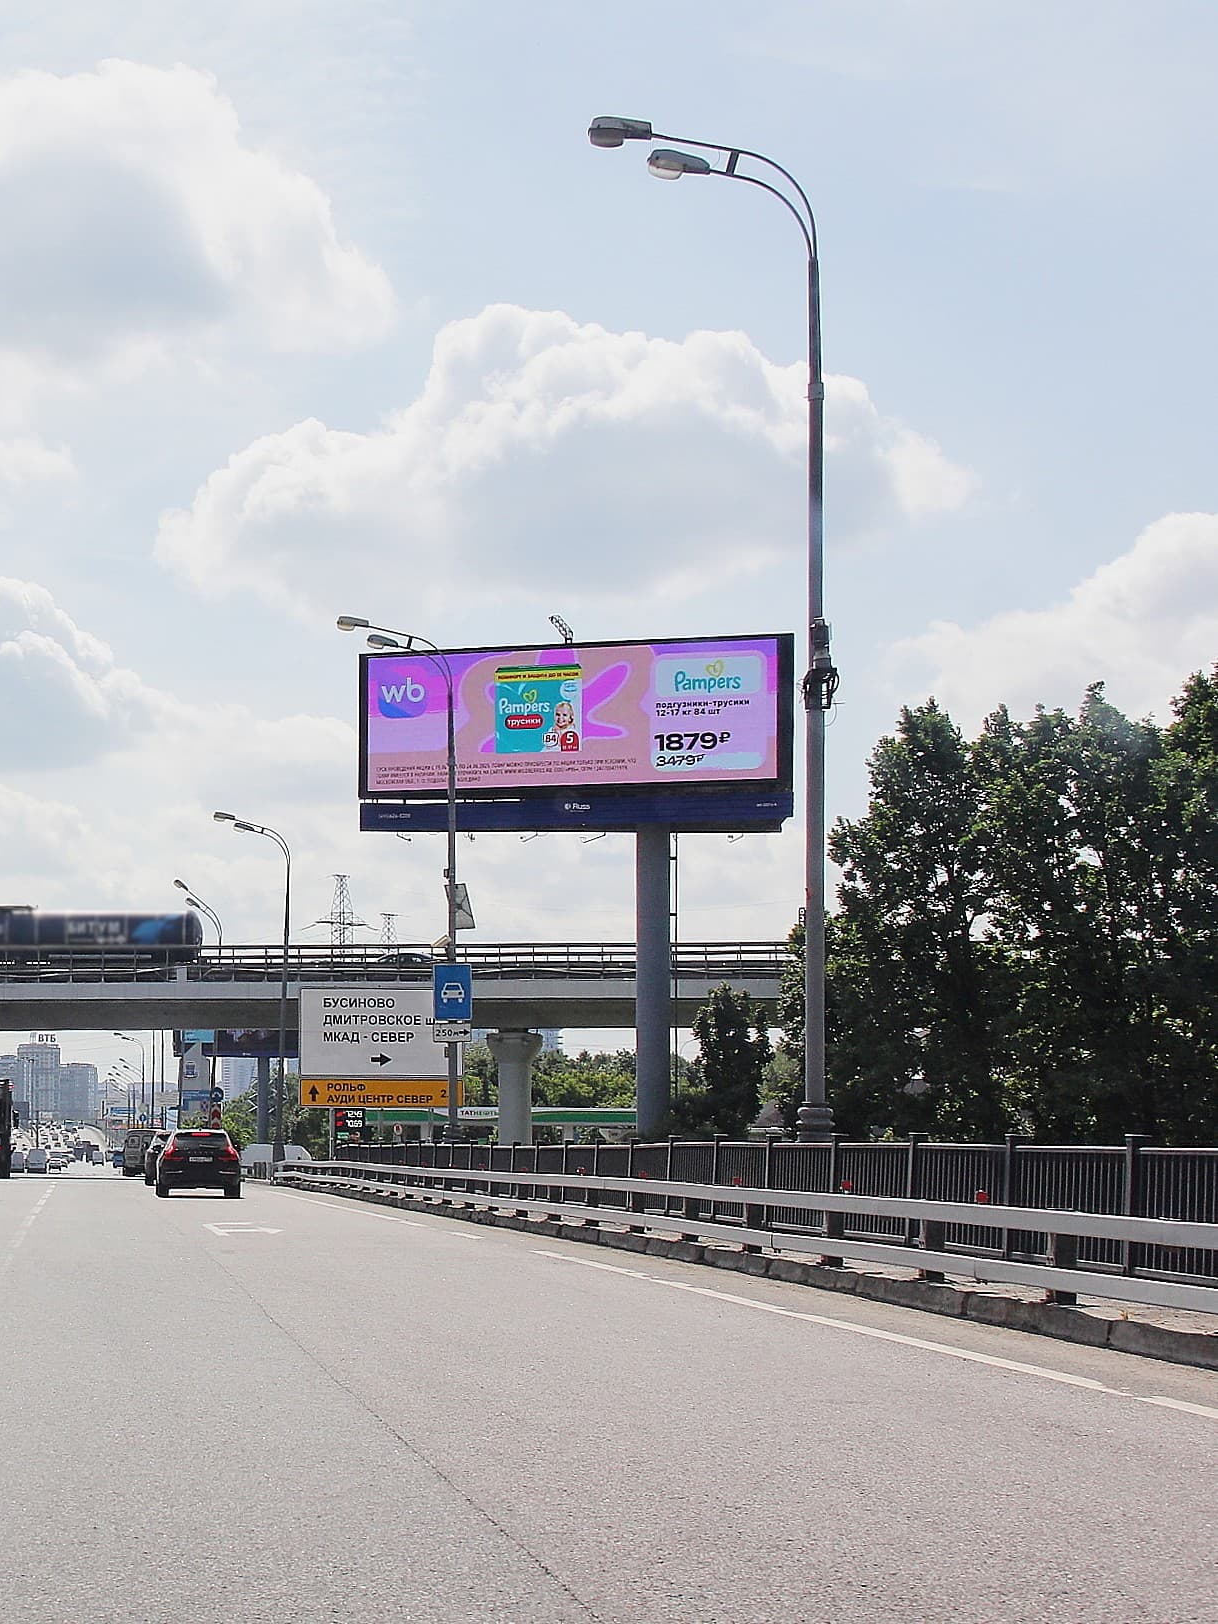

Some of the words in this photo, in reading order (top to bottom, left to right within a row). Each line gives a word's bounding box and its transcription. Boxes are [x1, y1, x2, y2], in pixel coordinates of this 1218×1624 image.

[674, 670, 742, 693] Pampers
[381, 676, 425, 703] wb
[499, 698, 551, 716] Pampers
[655, 699, 750, 709] подгузники-трусики
[656, 709, 680, 717] 12-17
[693, 708, 706, 716] 84
[565, 732, 574, 744] 5
[323, 997, 395, 1009] БУСИНОВО
[323, 1014, 422, 1027] ДМИТРОВСКОЕ
[38, 1033, 57, 1043] ВТБ
[323, 1031, 360, 1044] МКАД
[371, 1031, 415, 1043] СЕВЕР
[327, 1083, 367, 1092] РОЛЬФ
[326, 1094, 356, 1105] АУДИ
[358, 1094, 394, 1105] ЦЕНТР
[396, 1094, 433, 1104] СЕВЕР
